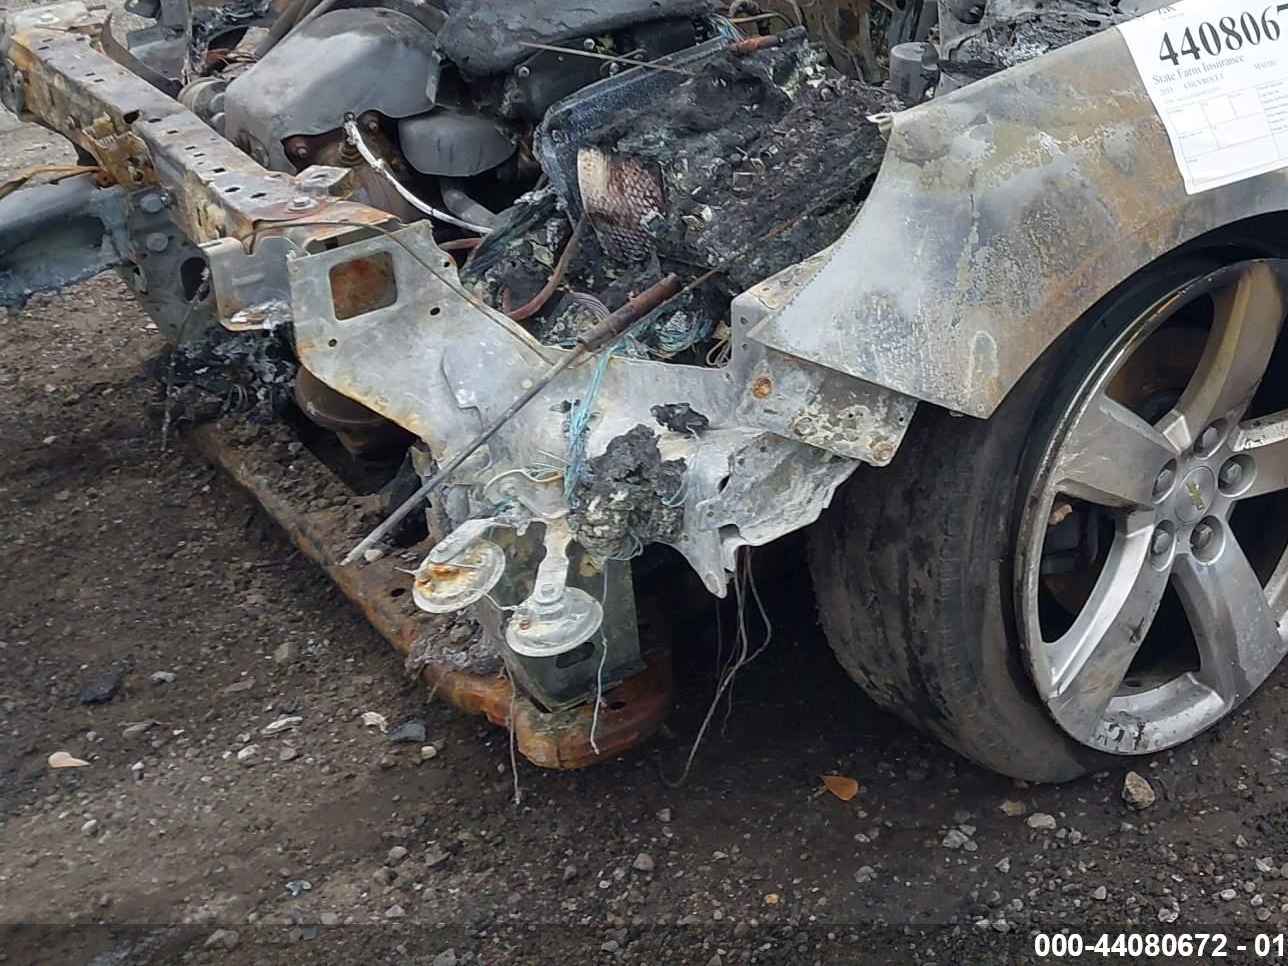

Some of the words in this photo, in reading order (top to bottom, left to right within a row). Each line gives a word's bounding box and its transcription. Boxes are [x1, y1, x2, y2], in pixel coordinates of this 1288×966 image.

[1152, 72, 1176, 85] State
[1176, 66, 1201, 79] Farm
[1201, 55, 1245, 72] Insurance
